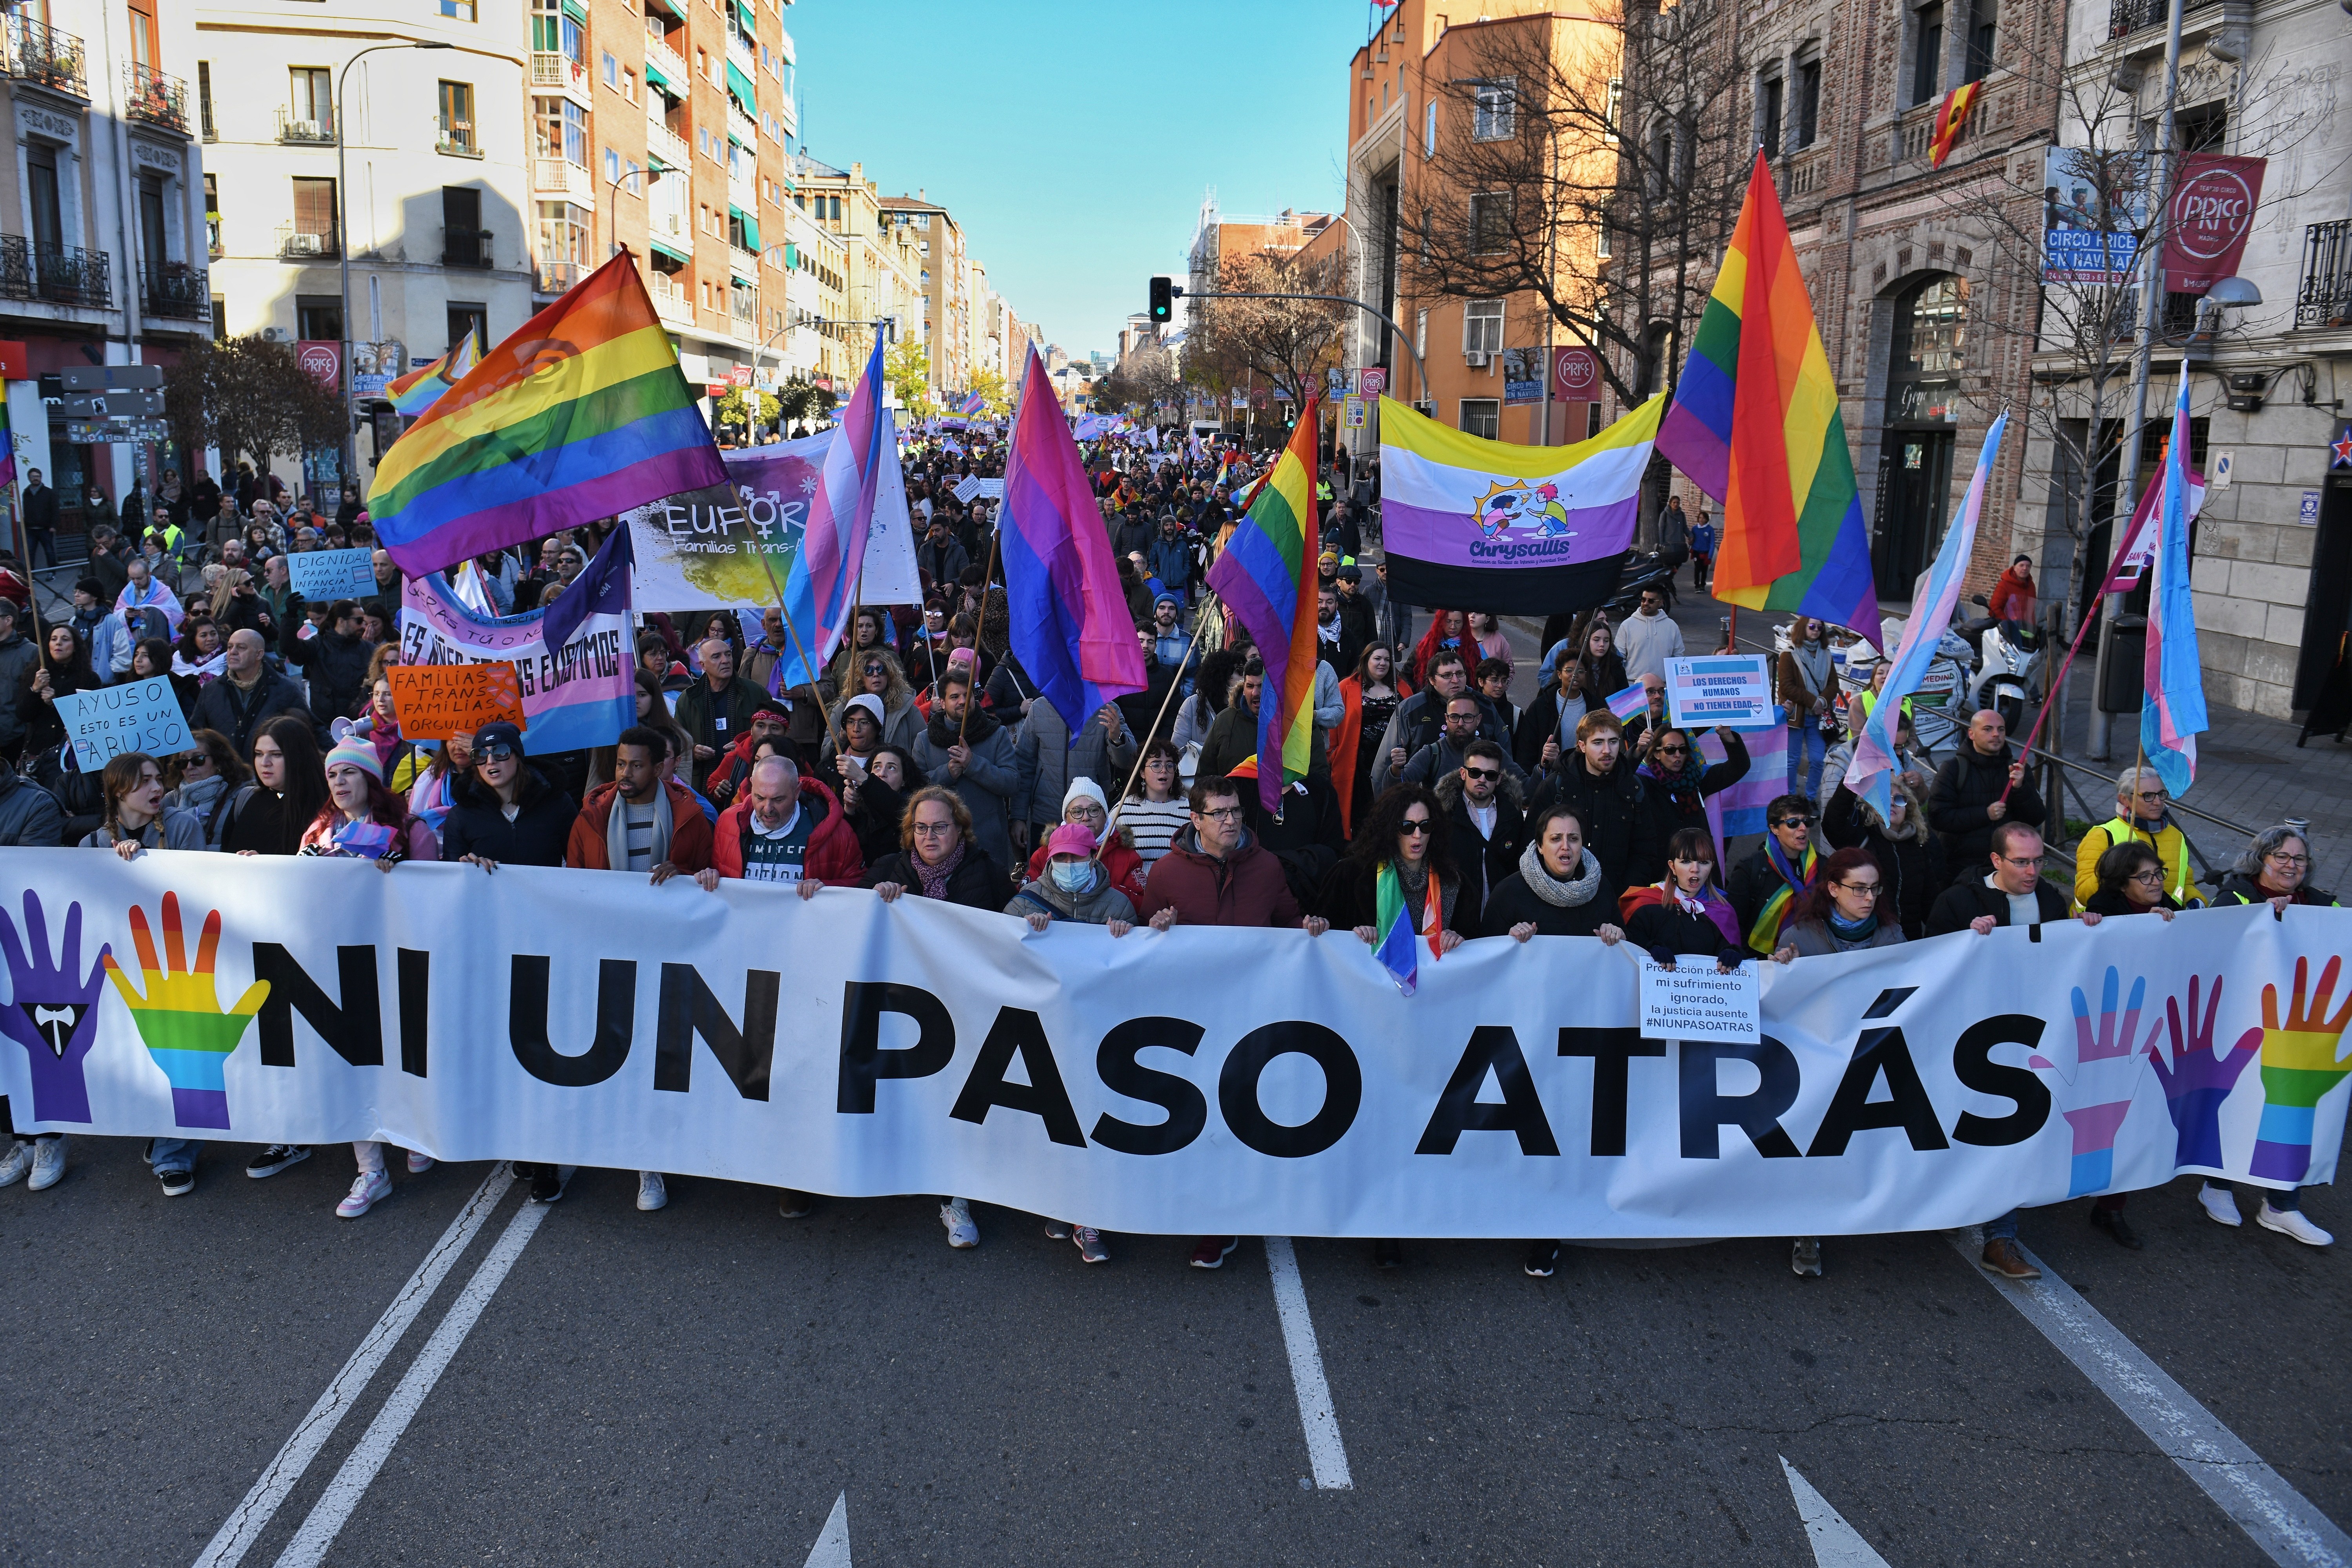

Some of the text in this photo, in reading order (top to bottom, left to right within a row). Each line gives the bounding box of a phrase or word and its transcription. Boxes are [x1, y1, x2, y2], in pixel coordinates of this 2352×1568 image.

[2182, 196, 2244, 231] PRICE
[2049, 233, 2091, 247] CIRCO
[304, 358, 331, 372] PRICE
[1563, 362, 1589, 376] PRICE
[1365, 378, 1378, 387] PRIC
[673, 538, 736, 554] Familias
[1469, 540, 1570, 560] Chrysallis
[2127, 551, 2142, 561] SAN
[302, 569, 331, 578] PARA
[309, 584, 355, 599] TRANS
[468, 629, 494, 645] TÚ
[502, 637, 514, 645] O
[1692, 676, 1747, 686] LOS DERECHOS
[416, 686, 486, 701] TRANS
[1702, 687, 1740, 697] HUMANOS
[78, 683, 162, 717] AYUSO
[1693, 700, 1752, 710] NO TIENEN EDAD
[80, 709, 172, 734] ESTO ES UN
[410, 710, 516, 731] ORGULLOSAS
[89, 723, 181, 763] ABUSO
[1646, 963, 1703, 974] Procción
[1656, 978, 1741, 991] mi sufrimiento
[1670, 992, 1728, 1007] ignorado,
[1651, 1005, 1748, 1019] la justicia ausente
[1646, 1017, 1754, 1032] #NIUNPASOATRAS
[252, 942, 2051, 1158] NI UN PASO ATRÁS
